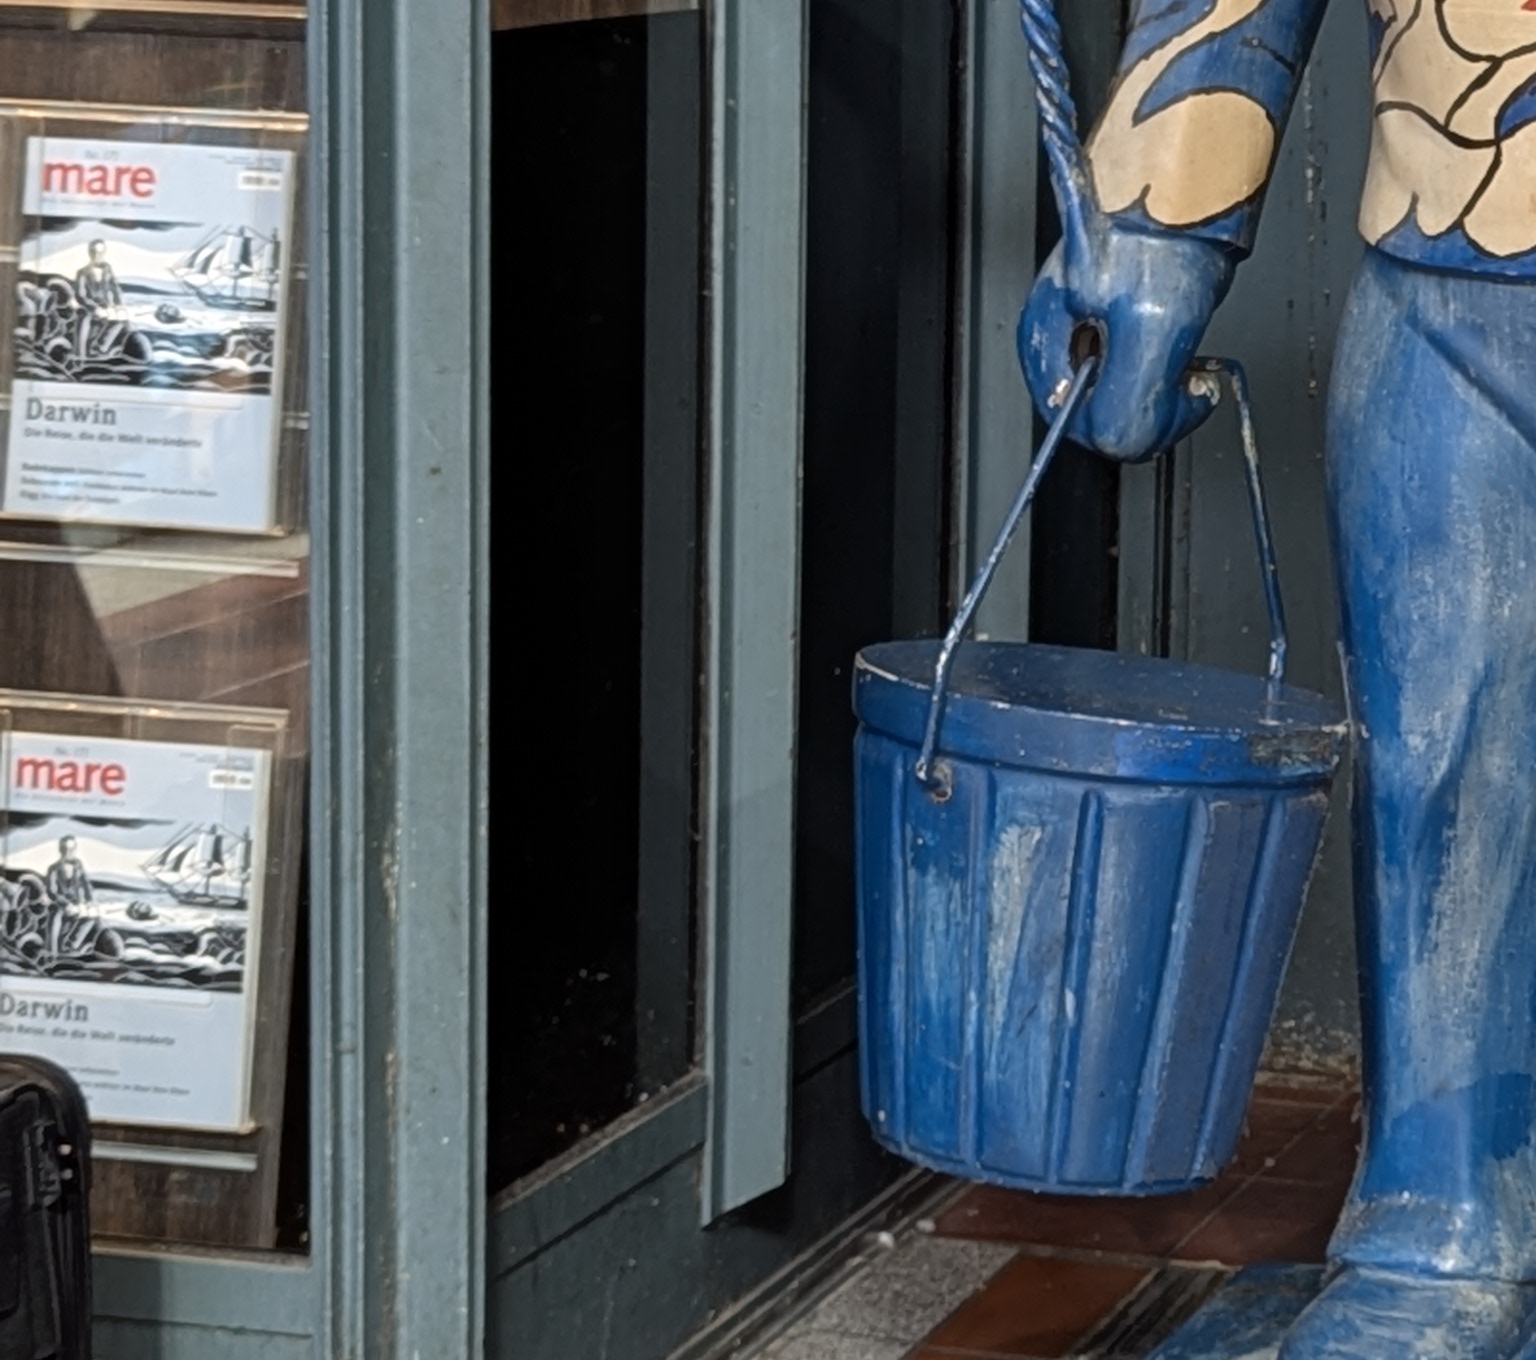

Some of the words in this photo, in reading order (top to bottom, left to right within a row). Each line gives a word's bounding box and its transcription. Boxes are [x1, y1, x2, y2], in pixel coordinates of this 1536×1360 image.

[42, 162, 156, 198] mare
[26, 397, 117, 426] Darwin
[16, 757, 127, 796] mare
[0, 993, 89, 1022] Darwin
